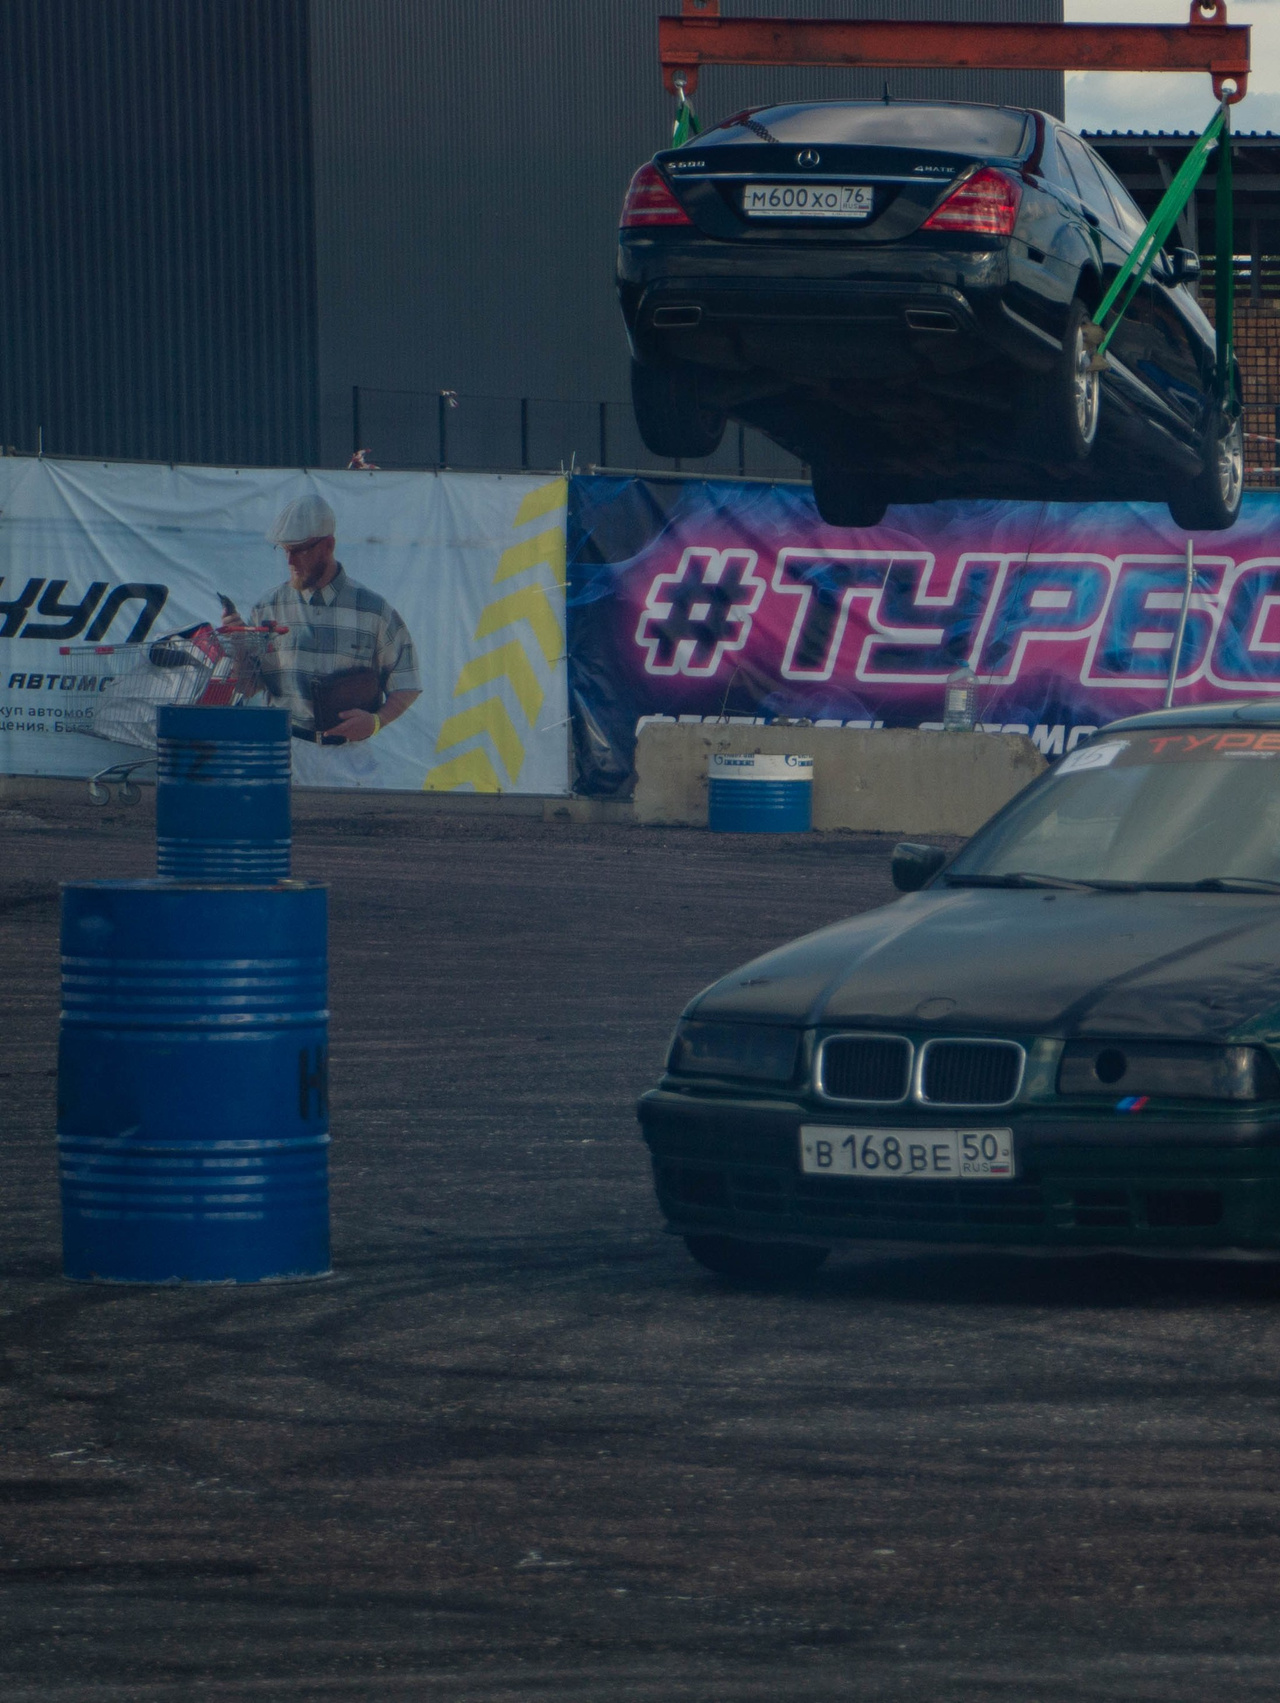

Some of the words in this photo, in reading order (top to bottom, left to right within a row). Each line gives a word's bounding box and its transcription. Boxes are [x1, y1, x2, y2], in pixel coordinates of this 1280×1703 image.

[845, 188, 865, 204] 76
[962, 1134, 999, 1160] 50
[962, 1163, 990, 1172] RUS
